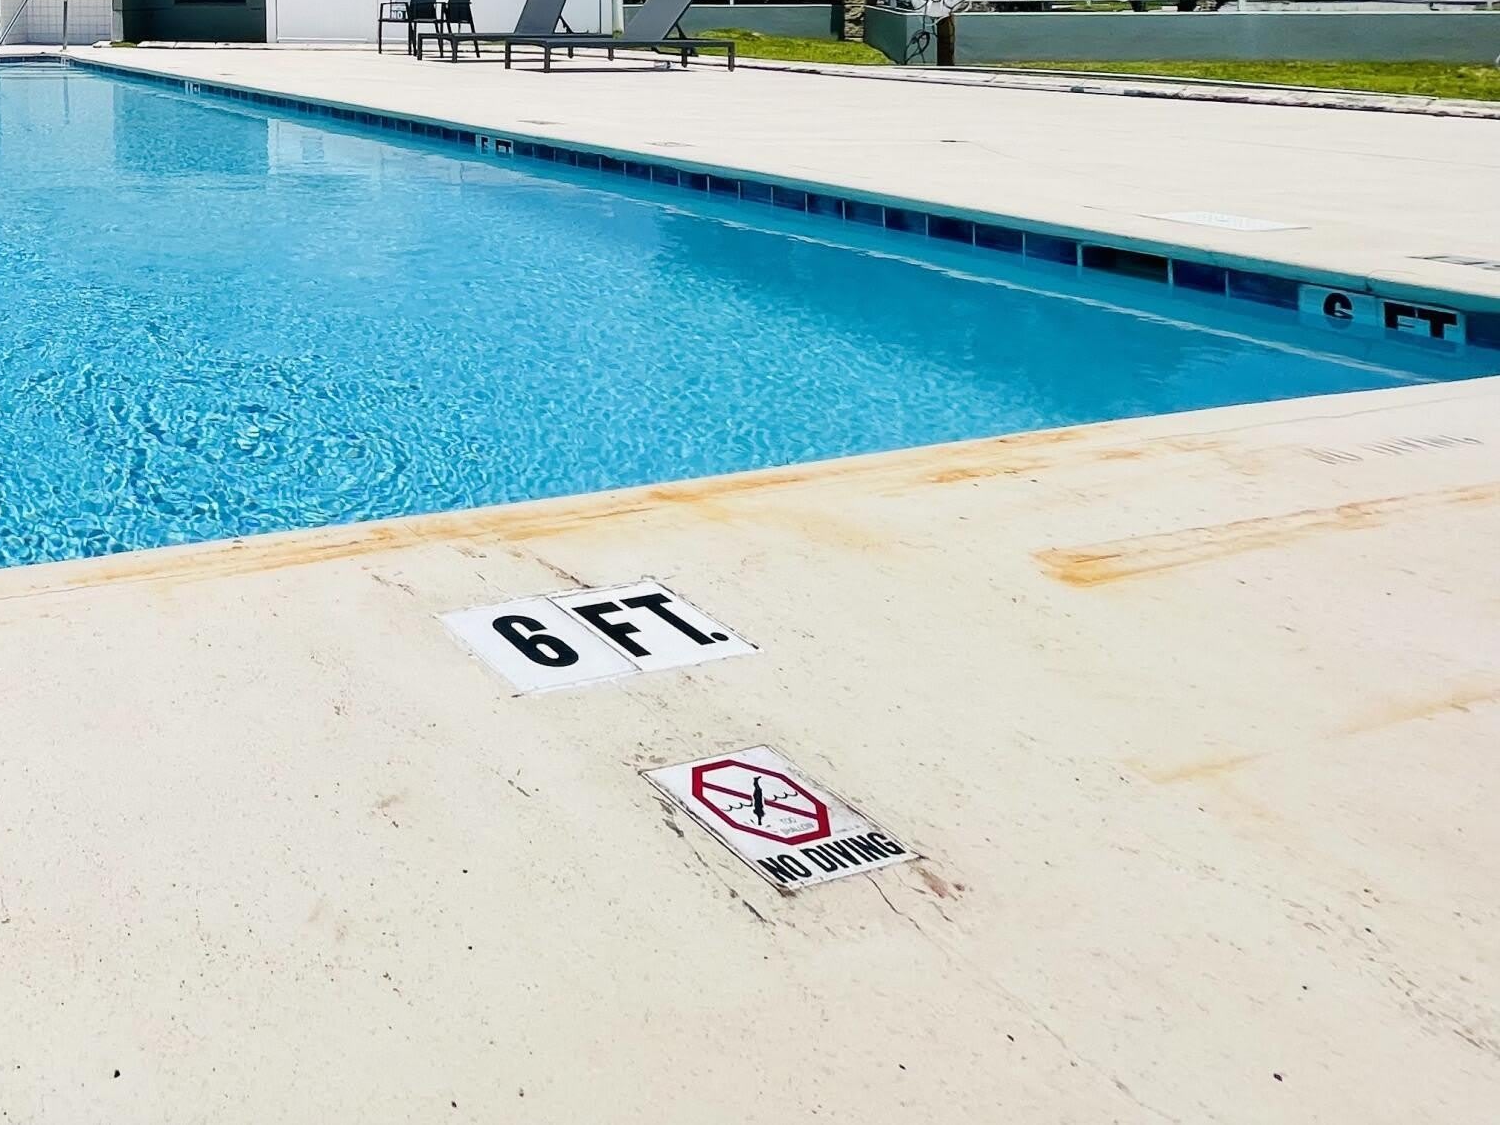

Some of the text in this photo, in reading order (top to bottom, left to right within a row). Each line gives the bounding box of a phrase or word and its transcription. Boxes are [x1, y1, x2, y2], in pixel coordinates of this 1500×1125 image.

[492, 593, 729, 667] 6 FT.
[757, 832, 906, 883] NO DIVING
